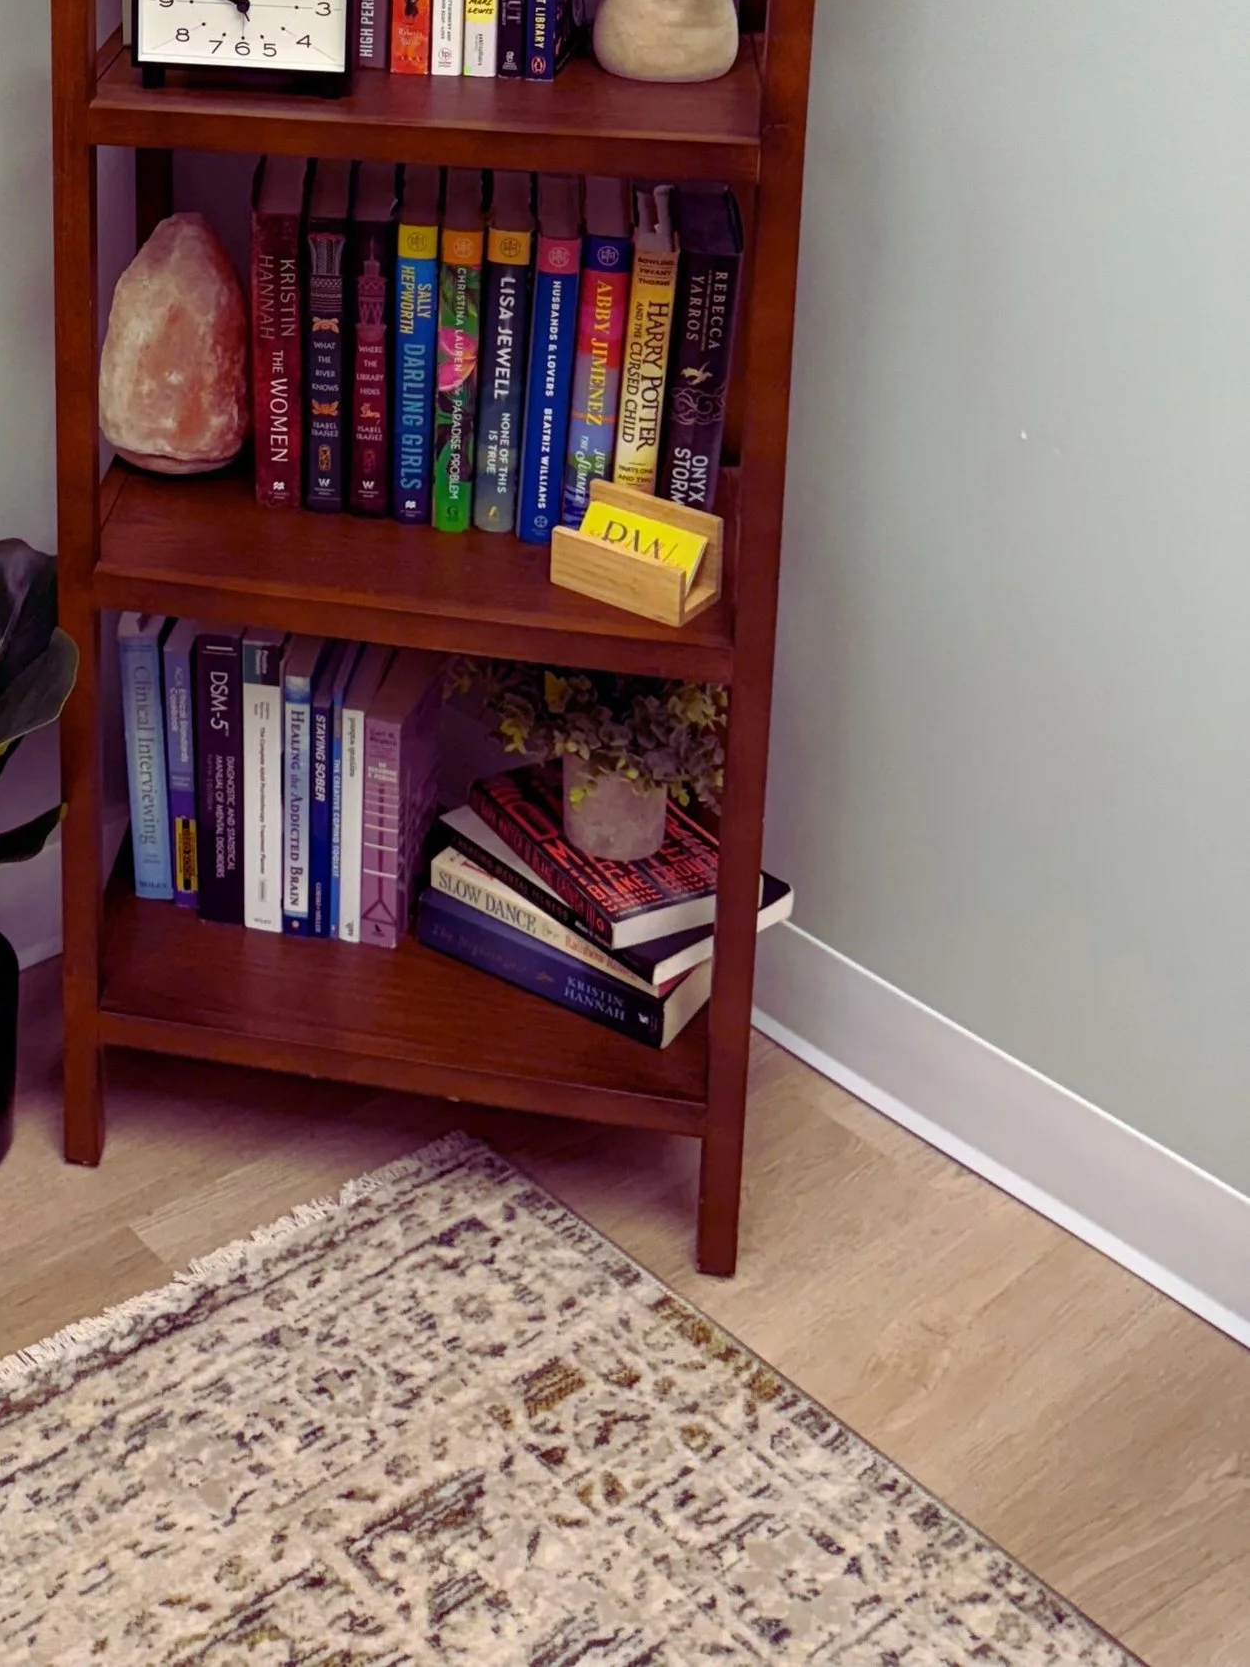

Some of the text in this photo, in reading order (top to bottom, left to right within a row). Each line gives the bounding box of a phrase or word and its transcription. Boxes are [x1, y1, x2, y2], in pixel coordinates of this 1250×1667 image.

[176, 28, 190, 42] 8
[316, 2, 331, 16] 3
[534, 8, 546, 48] LIBRARY
[209, 40, 223, 54] 7
[235, 42, 250, 56] 6
[262, 43, 277, 58] 5
[296, 35, 312, 48] 4
[360, 30, 374, 58] HIGH
[258, 255, 275, 340] HANNAH
[280, 259, 296, 336] KRISTIN
[400, 264, 415, 334] HEPWORTH
[417, 283, 432, 318] SALLY
[454, 267, 466, 372] CHRISTINA LAUREN
[549, 280, 562, 340] HUSBANDS
[686, 276, 705, 342] YARROS
[708, 270, 728, 350] REBECCA
[314, 341, 336, 350] WHAT
[318, 356, 331, 364] THE
[364, 360, 378, 368] THE
[494, 276, 516, 400] LISA JEWELL
[586, 280, 613, 426] ABBY JIMENEZ
[312, 383, 339, 392] KNOWS
[315, 370, 336, 378] RIVER
[356, 373, 384, 382] LIBRARY
[360, 388, 380, 396] HIDES
[402, 343, 426, 426] DARLING
[545, 354, 557, 397] LOVERS
[622, 302, 645, 444] AND THE CURSED CHILD
[636, 300, 670, 452] HARRY POTTER
[270, 350, 288, 462] THE WOMEN
[400, 434, 423, 490] GIRLS
[449, 399, 463, 500] PARADISE PROBLEM
[486, 430, 498, 474] IS TRUE
[497, 412, 510, 493] NONE OF THIS
[538, 408, 553, 509] BEATRIZ WILLIAMS
[594, 449, 606, 476] JUST
[688, 455, 708, 503] ONYX
[134, 666, 154, 732] Clinical
[210, 670, 228, 730] DSM-5
[315, 714, 326, 802] STAYING SOBER
[140, 738, 158, 845] Interviewing
[215, 754, 224, 878] MANUAL OF MENTAL DISORDERS
[226, 756, 236, 870] DIAGNOSTIC AND STATISTICAL
[290, 710, 305, 906] HEALING the ADDICTED BRAIN
[332, 813, 340, 842] COPING
[438, 872, 538, 934] SLOW DANCE
[588, 873, 651, 900] BLAKE
[564, 988, 626, 1022] HANNAH
[567, 976, 624, 1006] KRISTIN
